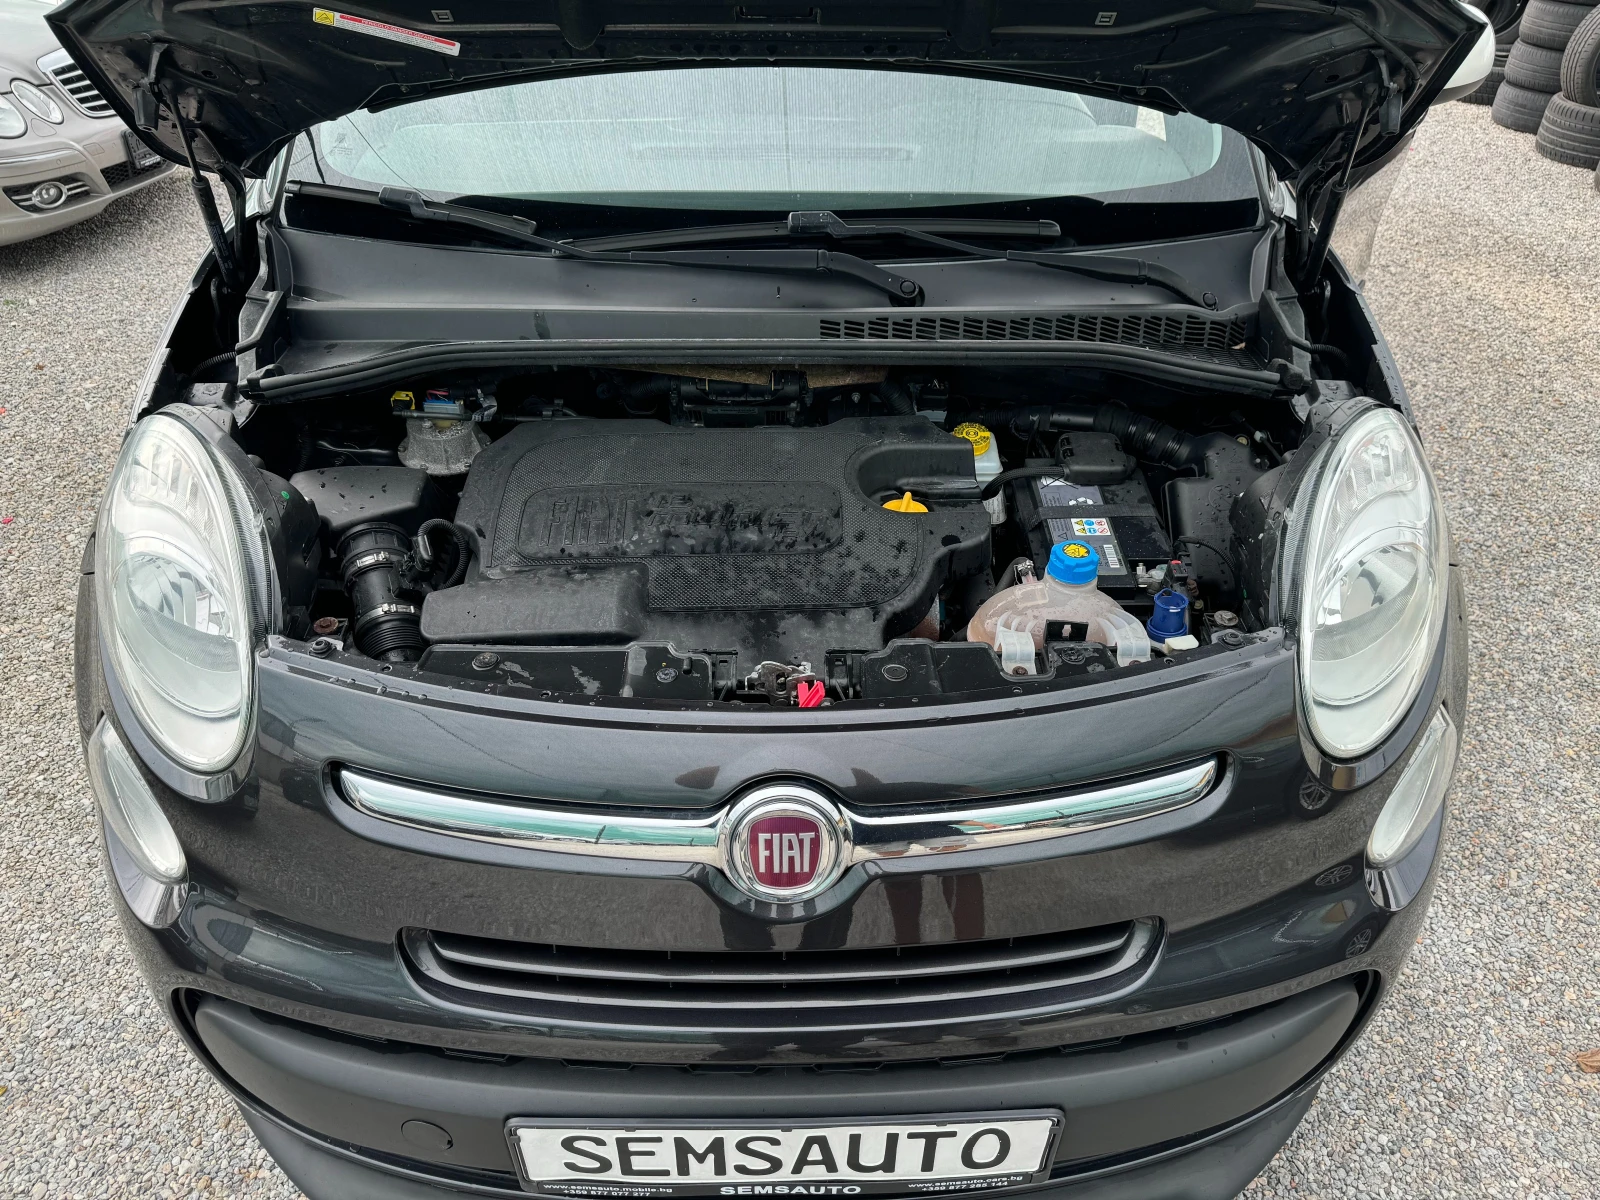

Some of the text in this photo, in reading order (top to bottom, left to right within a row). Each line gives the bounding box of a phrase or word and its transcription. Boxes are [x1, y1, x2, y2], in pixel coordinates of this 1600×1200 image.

[538, 494, 638, 547] FIAT
[757, 831, 815, 874] FIAT
[559, 1127, 1012, 1176] SEMSAUTO
[720, 1185, 862, 1195] SEMSAUTO
